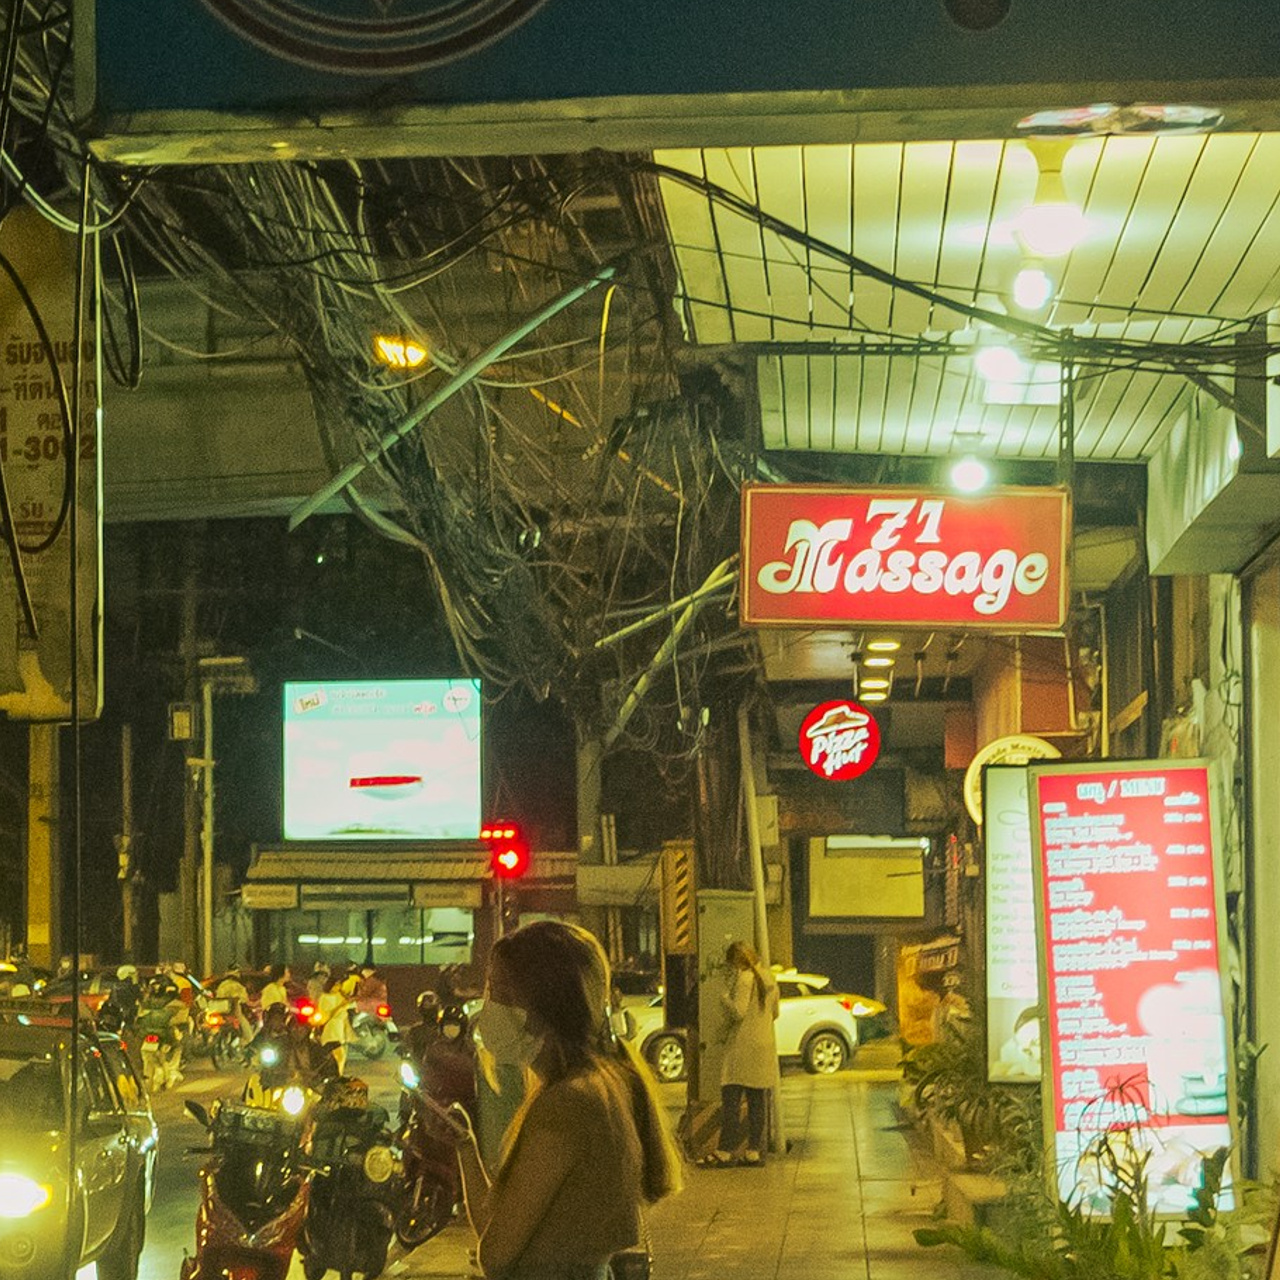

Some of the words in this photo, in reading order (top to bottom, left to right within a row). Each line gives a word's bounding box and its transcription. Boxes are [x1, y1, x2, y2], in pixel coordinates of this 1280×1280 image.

[866, 498, 946, 552] 71
[757, 518, 1050, 616] Massage
[822, 741, 869, 777] Hut
